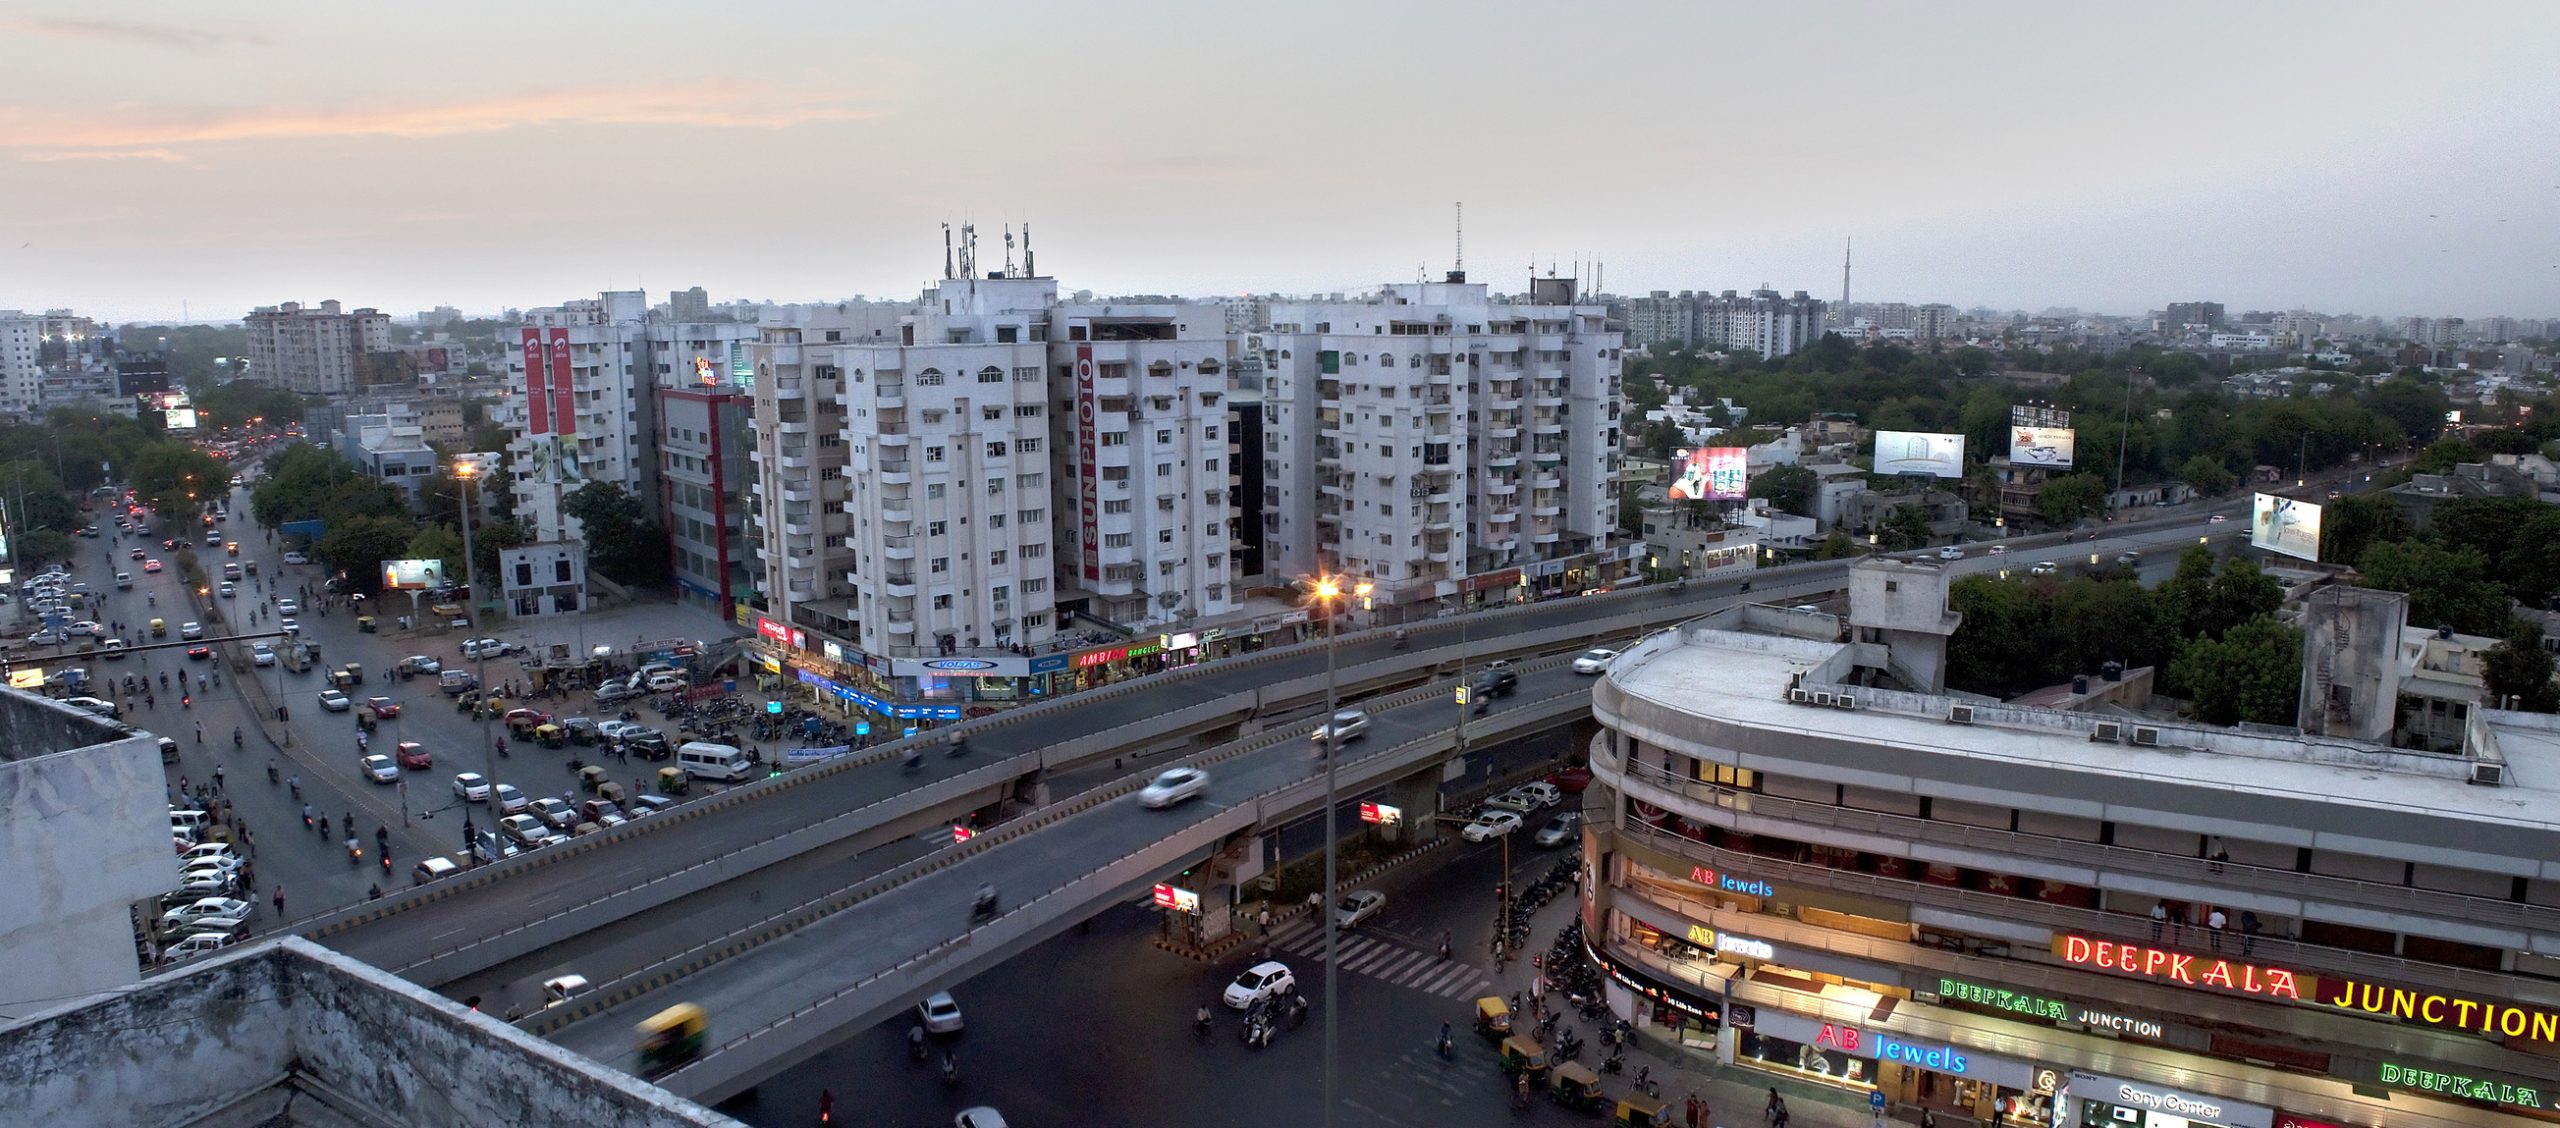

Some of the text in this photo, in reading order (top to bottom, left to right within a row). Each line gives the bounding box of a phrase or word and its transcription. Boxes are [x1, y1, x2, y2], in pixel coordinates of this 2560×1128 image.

[1079, 358, 1097, 546] SUN PHOTO
[940, 660, 980, 669] VOLTAS
[1079, 647, 1127, 667] AMBICA
[1127, 645, 1160, 657] BANGLES
[1691, 866, 1774, 897] AB Jewels
[1687, 925, 1773, 959] AB Jewels
[2065, 935, 2558, 1043] DEEPKALA JUNCTION
[1938, 978, 2162, 1039] DEEPKALA JUNCTION
[1816, 1023, 1968, 1074] AB Jewels
[2074, 1073, 2098, 1081] SONY
[2381, 1063, 2541, 1108] DEEPKALA
[2119, 1084, 2221, 1119] Sony Center
